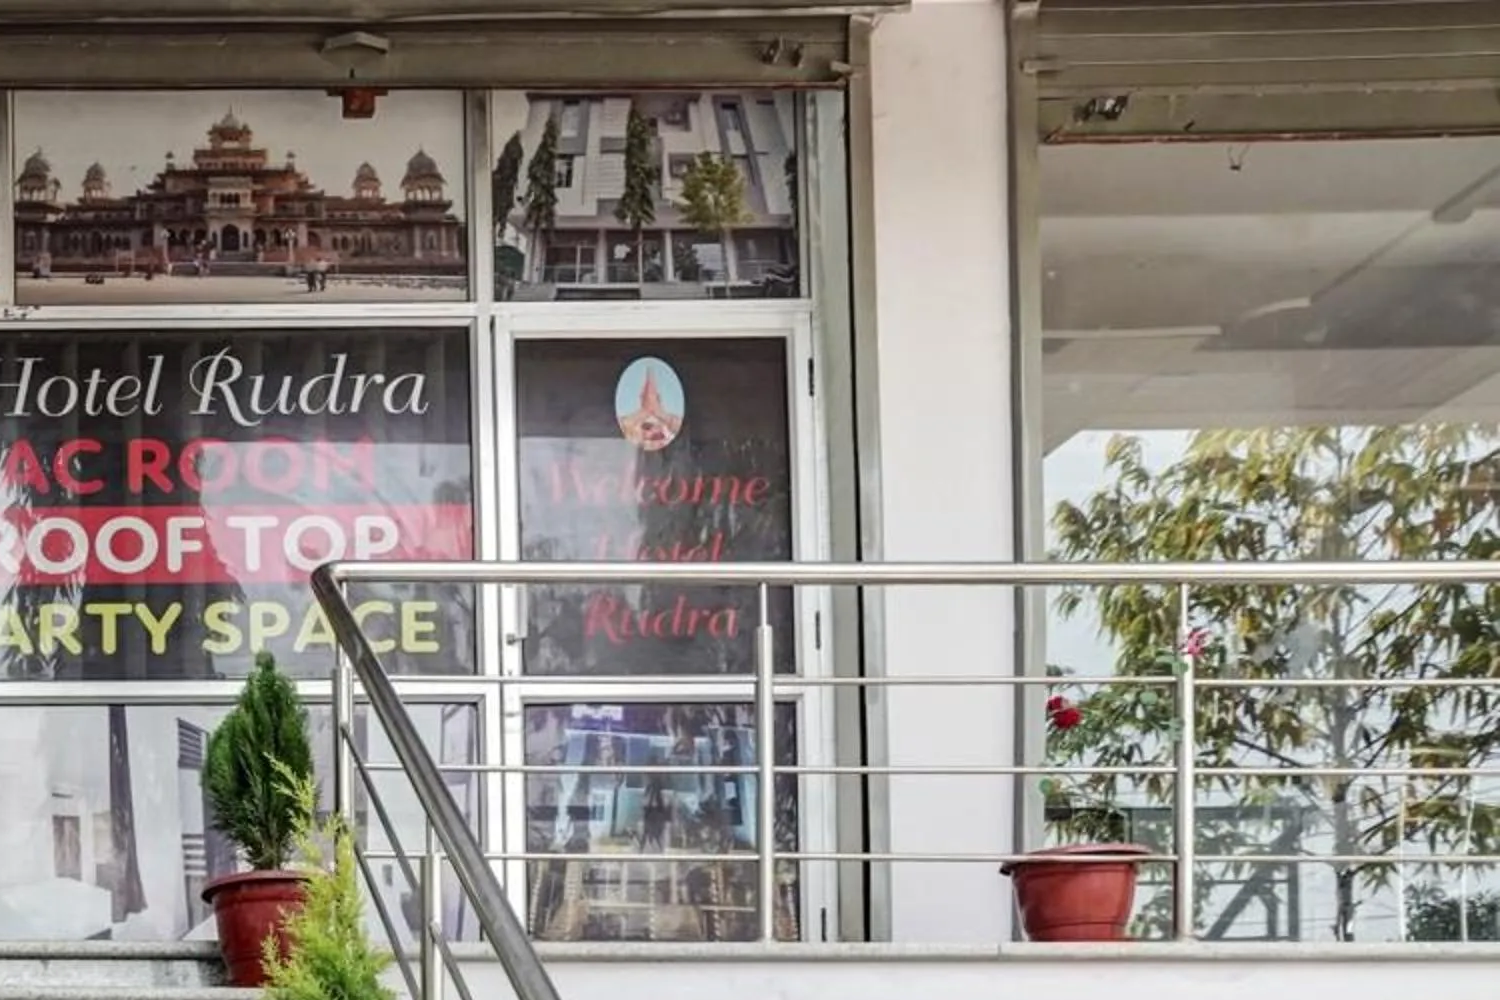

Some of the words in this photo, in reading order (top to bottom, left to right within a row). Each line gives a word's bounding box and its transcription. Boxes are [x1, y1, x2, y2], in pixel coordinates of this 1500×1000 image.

[189, 346, 429, 427] Rudra
[128, 438, 375, 494] ROOM
[546, 456, 770, 505] Welcome
[227, 515, 399, 573] TOP
[202, 602, 440, 655] SPACE
[583, 590, 739, 645] Rudra
